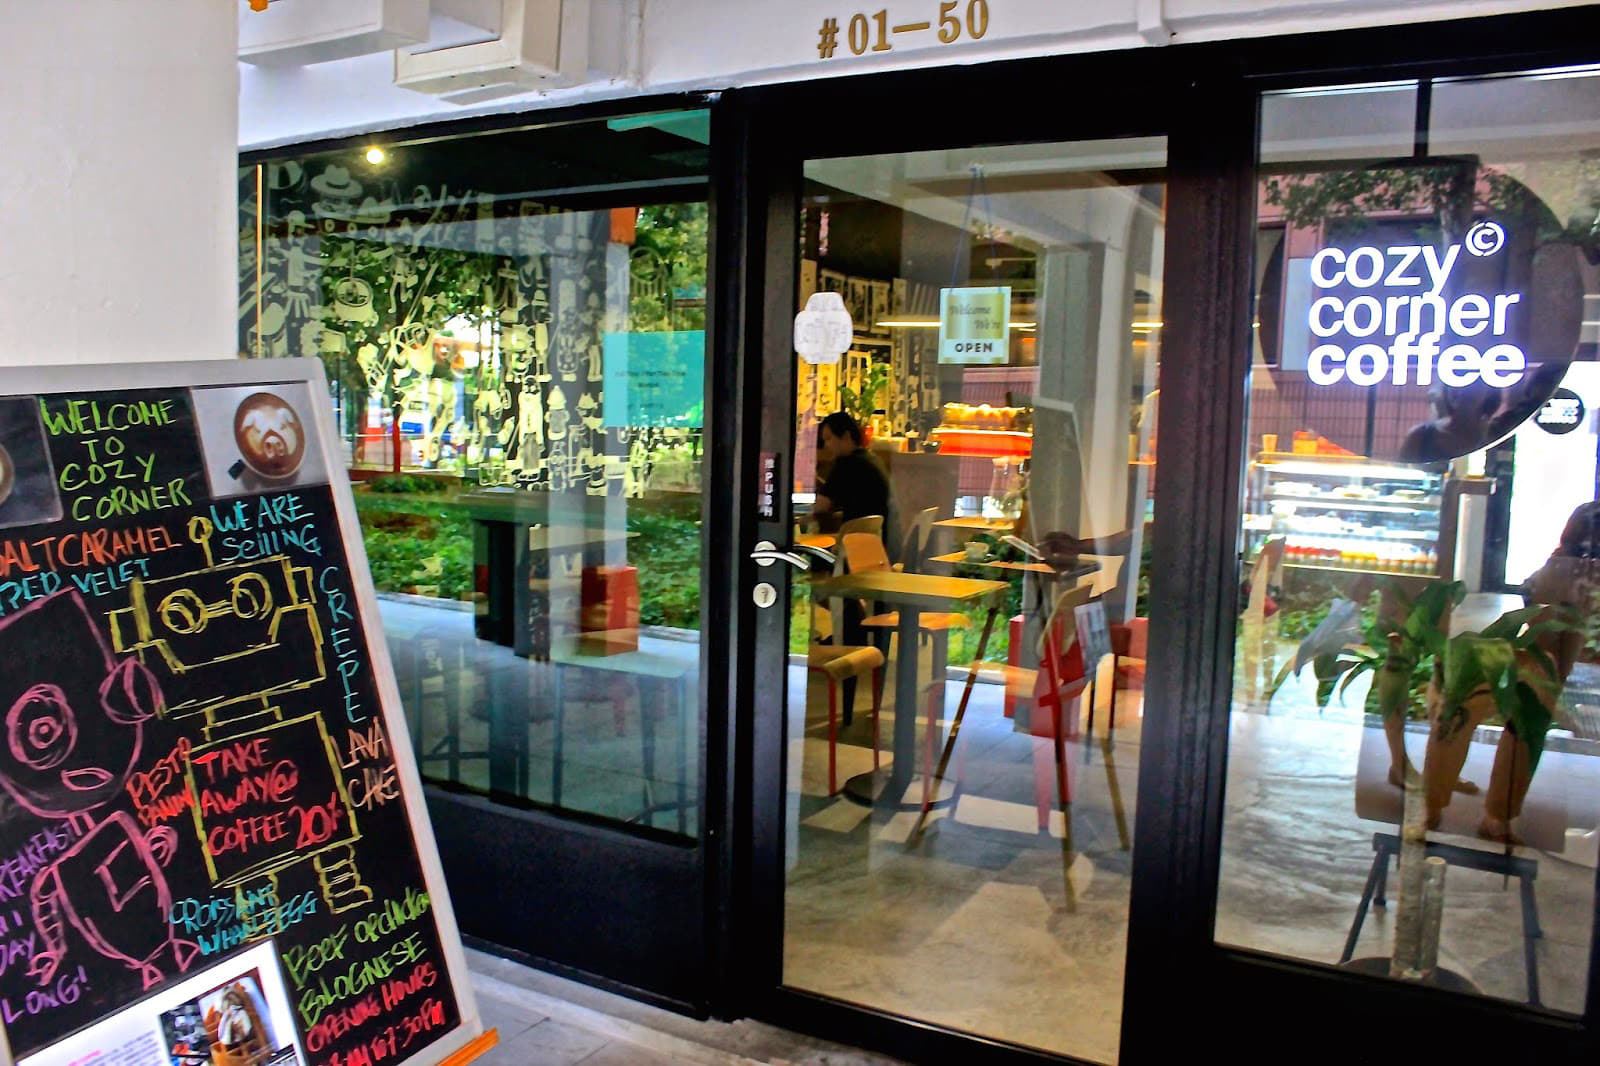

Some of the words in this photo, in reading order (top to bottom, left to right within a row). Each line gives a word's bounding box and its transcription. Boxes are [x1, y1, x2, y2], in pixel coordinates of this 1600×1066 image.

[1310, 244, 1462, 298] cozy
[1308, 293, 1521, 337] corner
[954, 342, 993, 353] OPEN
[1307, 331, 1526, 388] coffee
[40, 397, 177, 436] WELCOME
[80, 436, 125, 462] TO
[60, 453, 155, 491] COZY
[72, 479, 192, 521] CORNER
[209, 501, 253, 532] WE
[258, 493, 314, 528] ARE
[71, 558, 150, 597] VELET
[319, 566, 367, 723] CREPE
[192, 738, 271, 783] TAKE
[208, 811, 291, 855] COFFEE
